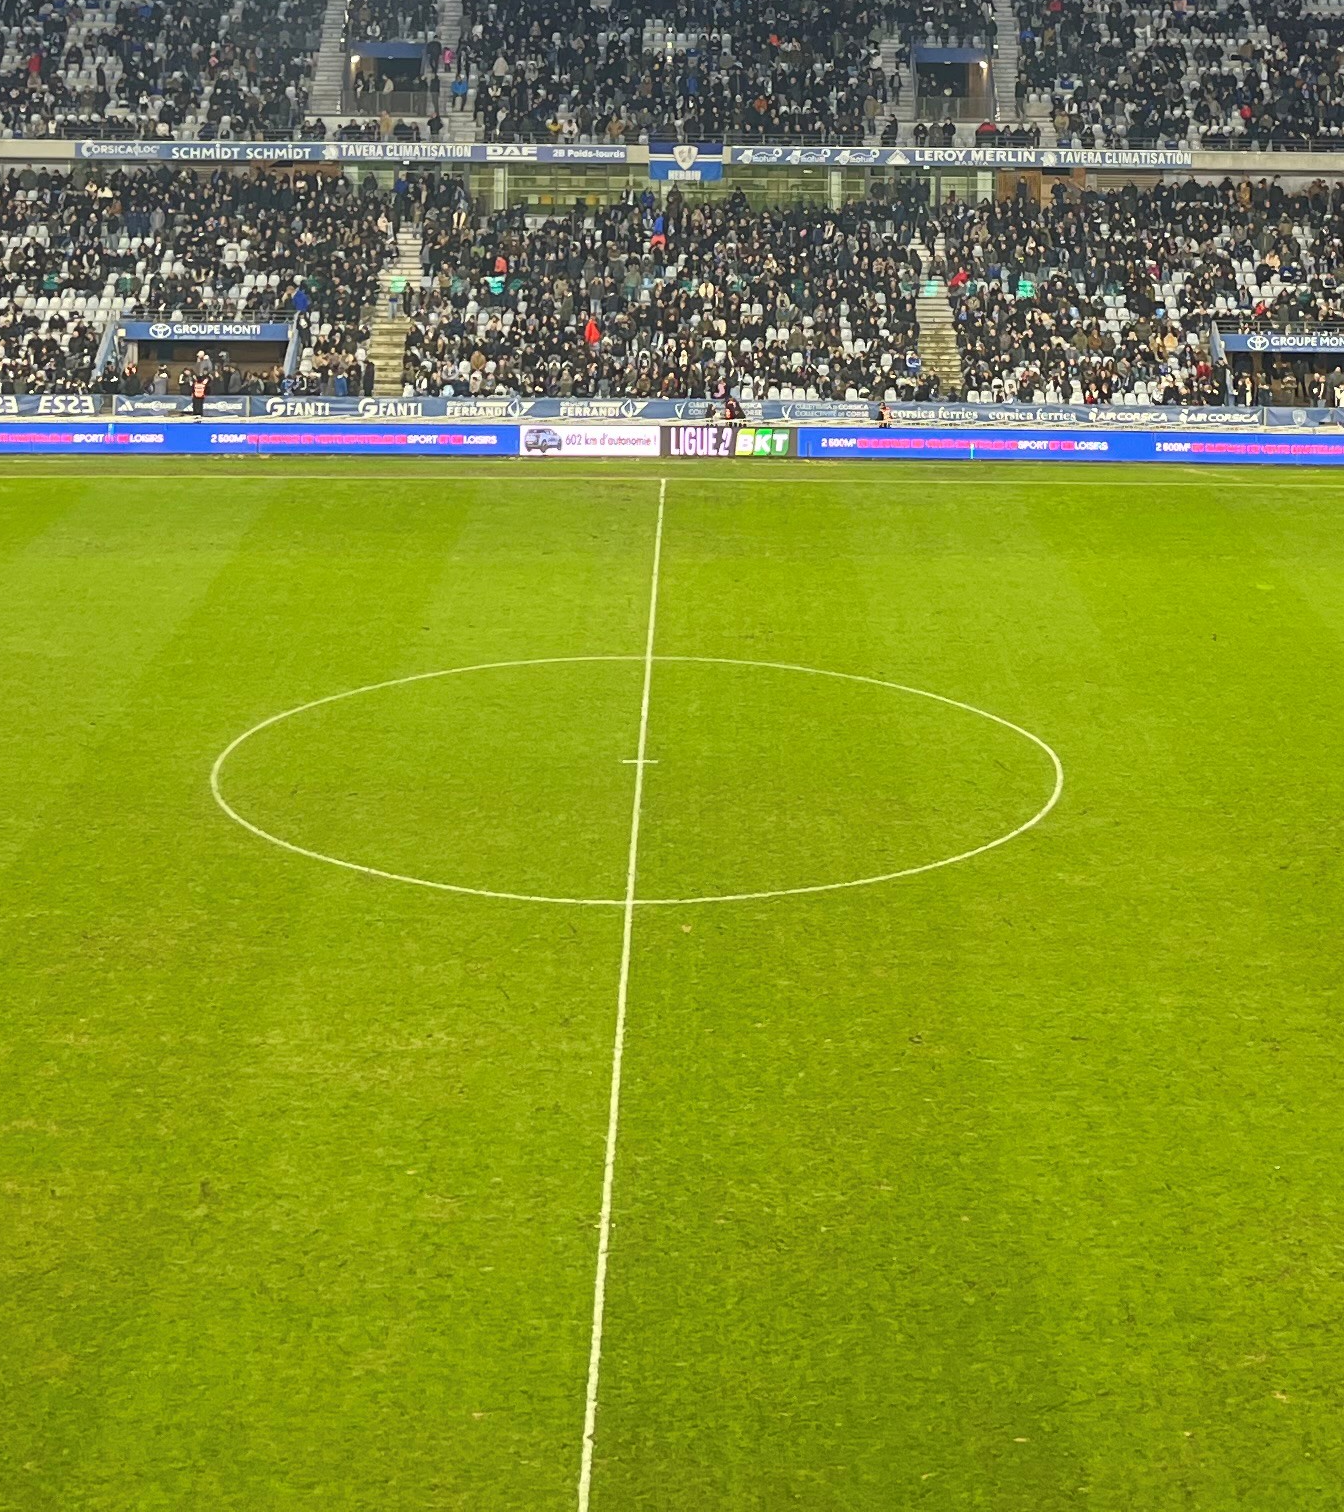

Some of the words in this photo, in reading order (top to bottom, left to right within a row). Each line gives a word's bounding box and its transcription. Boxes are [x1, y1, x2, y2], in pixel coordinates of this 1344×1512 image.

[171, 143, 240, 160] SCHMIDT
[245, 143, 311, 160] SCHMIDT
[341, 144, 383, 157] TAVERA
[386, 144, 472, 158] CLIMATISATION
[486, 146, 538, 156] DAF
[915, 150, 967, 162] LEROY
[971, 150, 1036, 162] MERLIN
[1058, 151, 1103, 164] TAVERA
[1105, 150, 1192, 165] CLIMATISATION
[173, 324, 221, 335] GROUPE
[222, 324, 261, 335] MONTI
[1270, 336, 1318, 347] GROUPE
[286, 402, 331, 416] FANTI
[378, 402, 423, 417] FANTI
[446, 406, 507, 417] FERRANDI
[559, 406, 620, 417] FERRANDI
[891, 407, 936, 420] corsica
[937, 406, 979, 420] ferries
[988, 408, 1034, 421] corsica
[1036, 408, 1077, 421] ferries
[1096, 412, 1117, 421] AIR
[1117, 412, 1168, 422] CORSICA
[1186, 413, 1207, 422] AIR
[1207, 413, 1259, 422] CORSICA
[72, 433, 105, 443] SPORT
[129, 433, 164, 443] LOISIRS
[406, 434, 438, 445] SPORT
[463, 434, 498, 445] LOISIRS
[565, 433, 582, 445] 602
[584, 432, 598, 445] km
[599, 432, 651, 445] d'autonomie
[670, 427, 718, 456] LIGUE
[718, 427, 733, 456] 2
[737, 434, 790, 452] BKT
[1017, 440, 1049, 450] SPORT
[1074, 441, 1109, 451] LOISIRS
